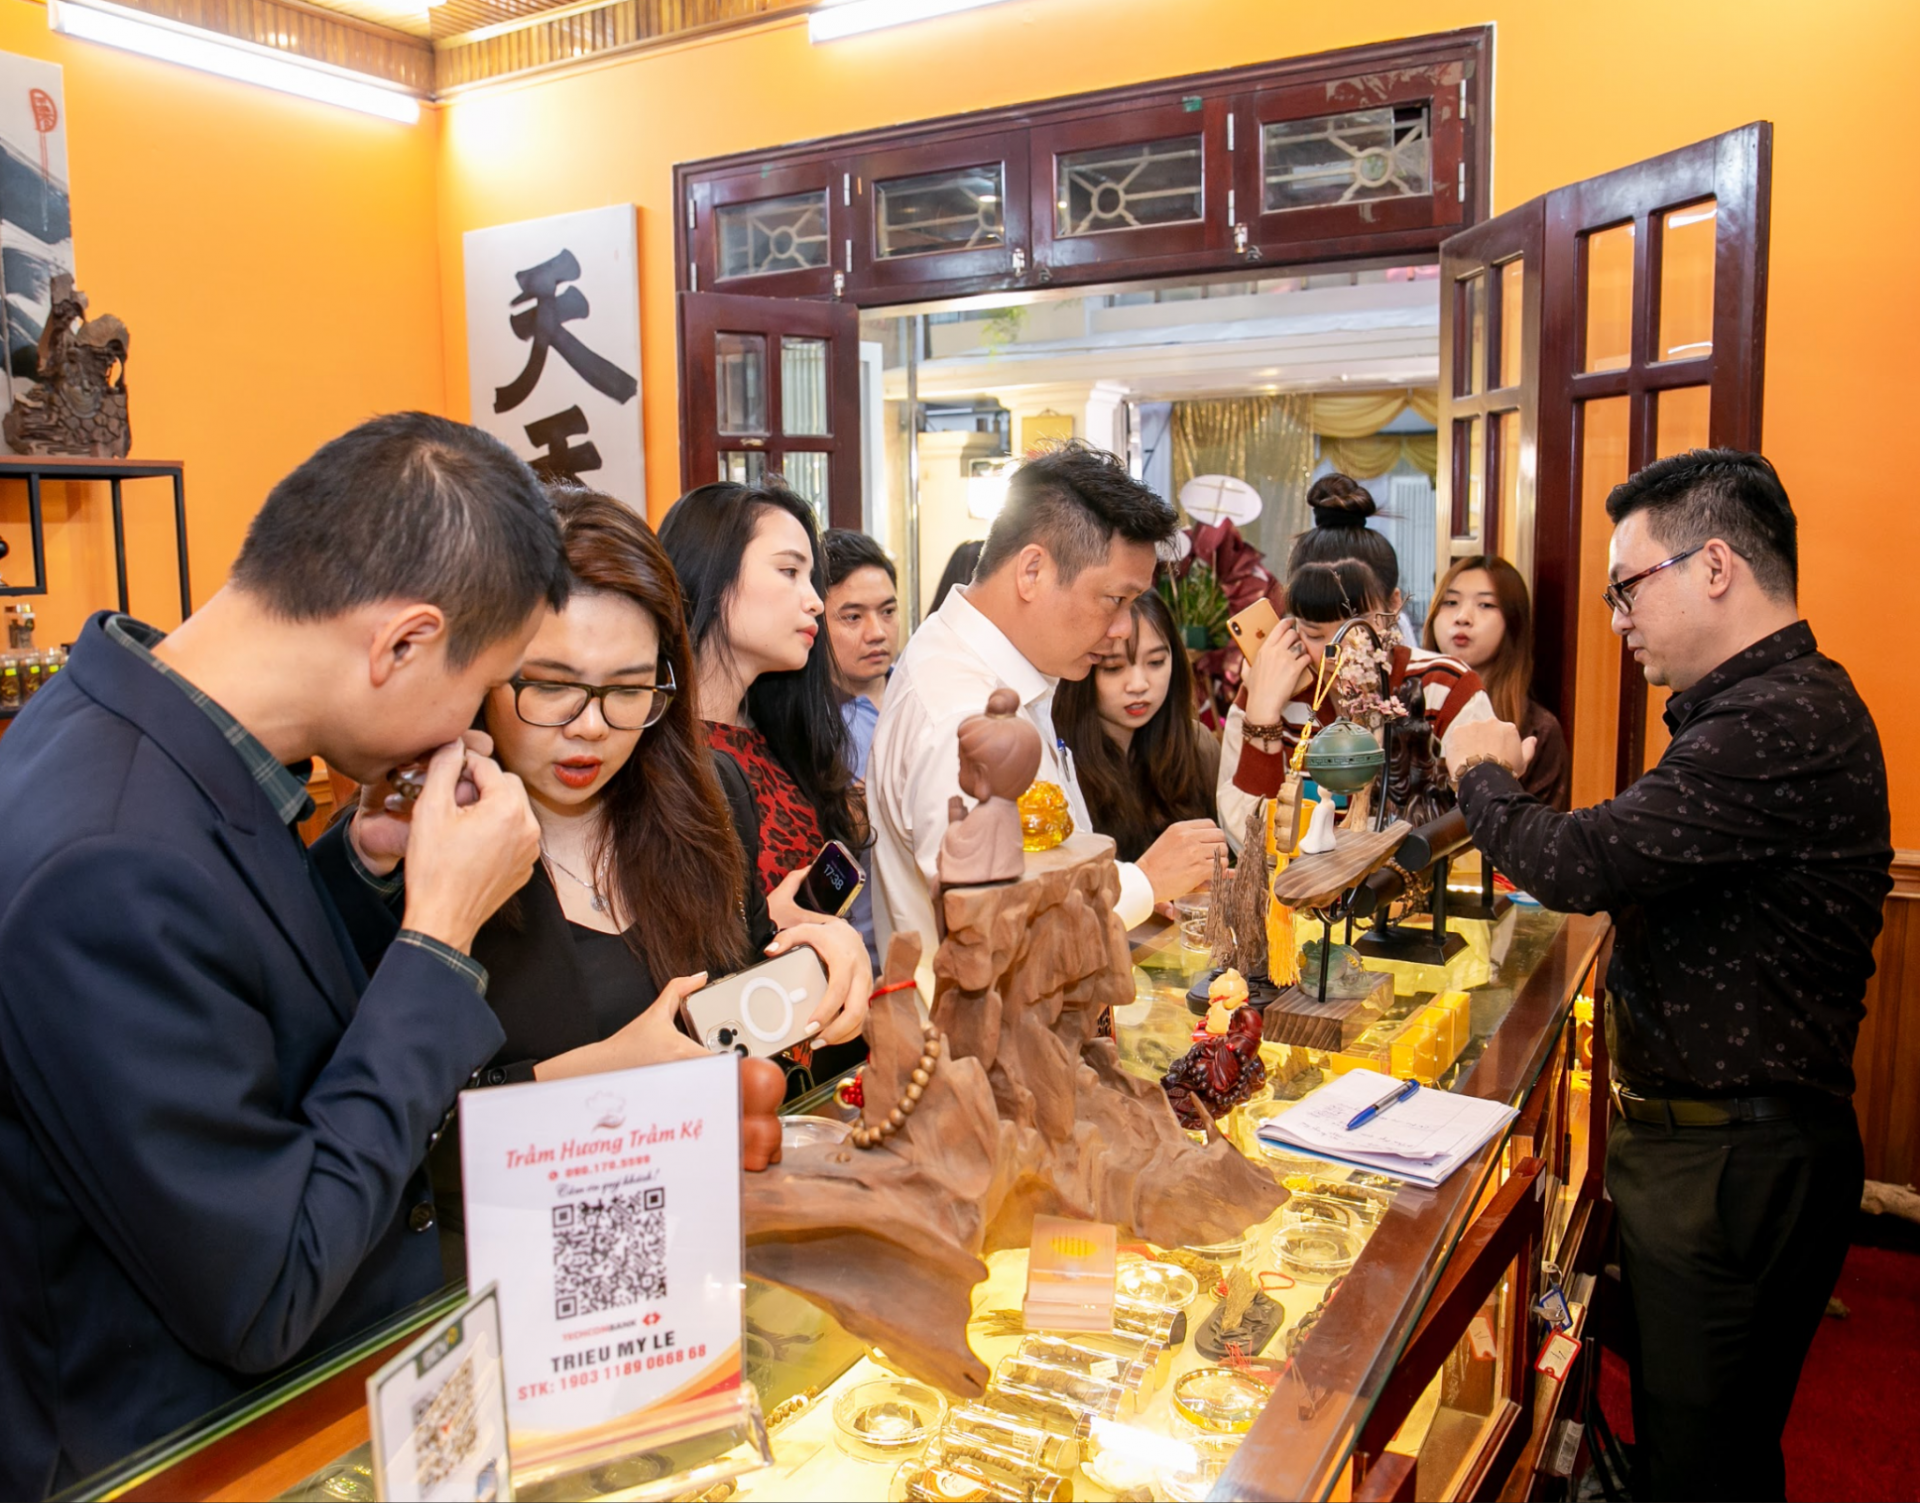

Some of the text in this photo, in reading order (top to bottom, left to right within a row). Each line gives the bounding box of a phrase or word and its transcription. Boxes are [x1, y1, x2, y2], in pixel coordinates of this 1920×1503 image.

[823, 863, 844, 890] 17:38
[562, 1319, 637, 1341] TECHCOMBANK
[551, 1331, 676, 1373] TRIEU MY LE
[518, 1344, 707, 1401] STK: 1903 1189 0668 68
